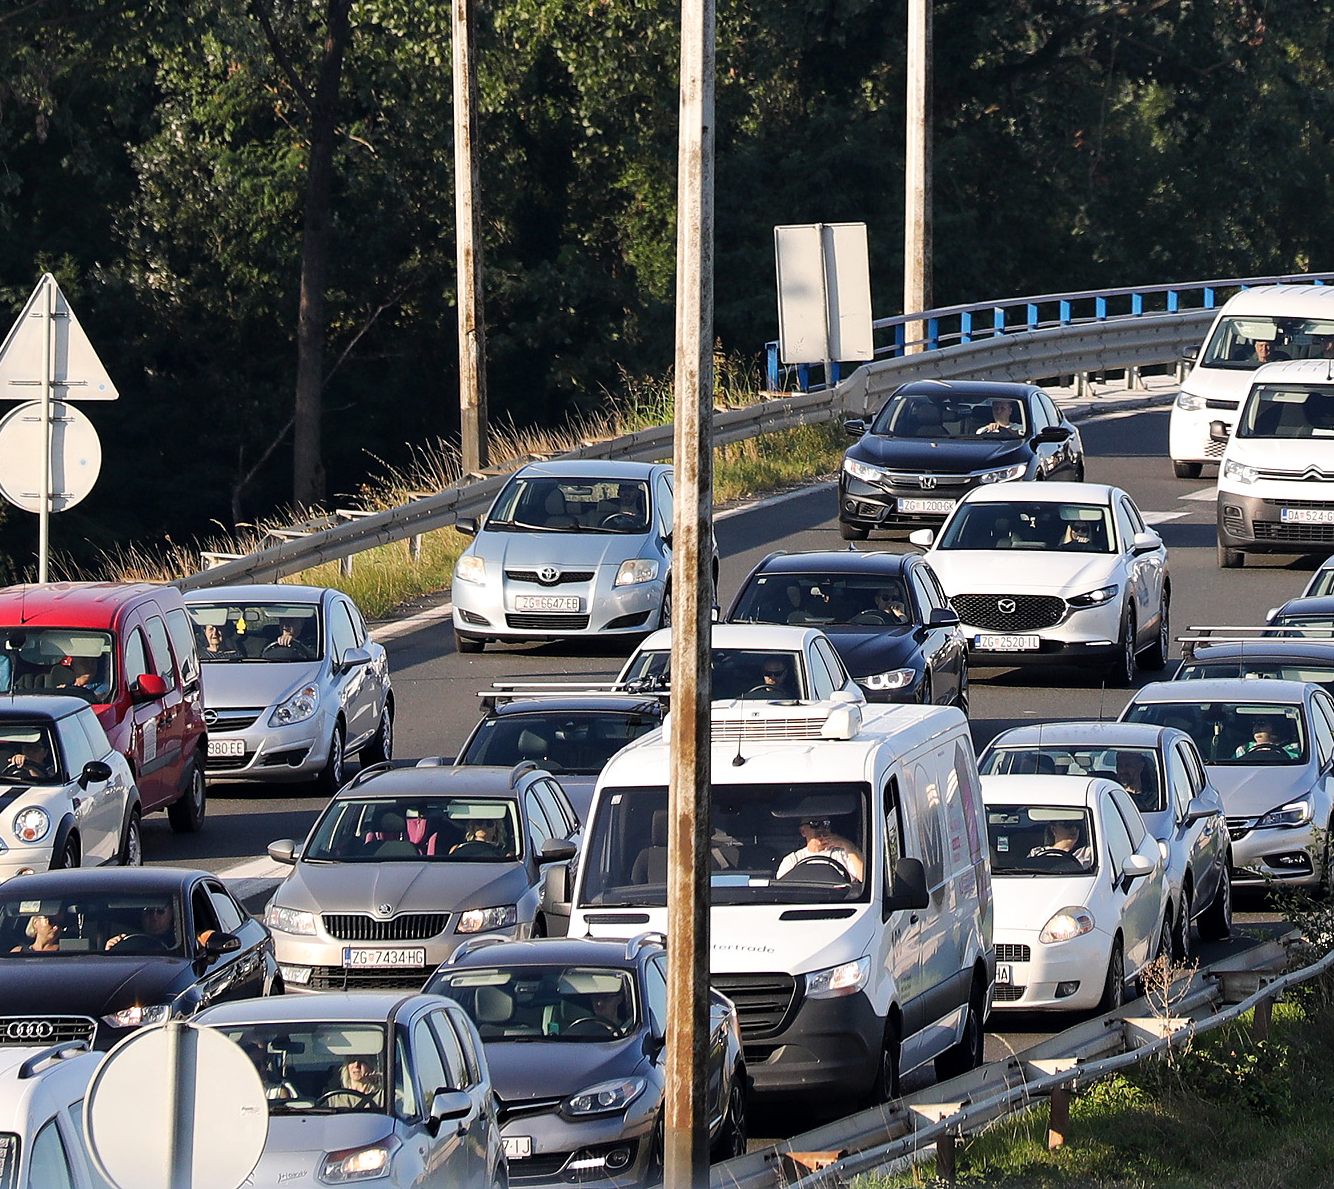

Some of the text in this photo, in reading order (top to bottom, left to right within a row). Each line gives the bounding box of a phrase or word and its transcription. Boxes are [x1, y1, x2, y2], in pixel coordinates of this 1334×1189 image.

[904, 500, 915, 511] ZG
[1288, 510, 1299, 520] DA
[523, 597, 535, 609] ZG
[982, 636, 994, 648] ZG
[713, 943, 775, 954] tertrade
[352, 951, 367, 965] ZG
